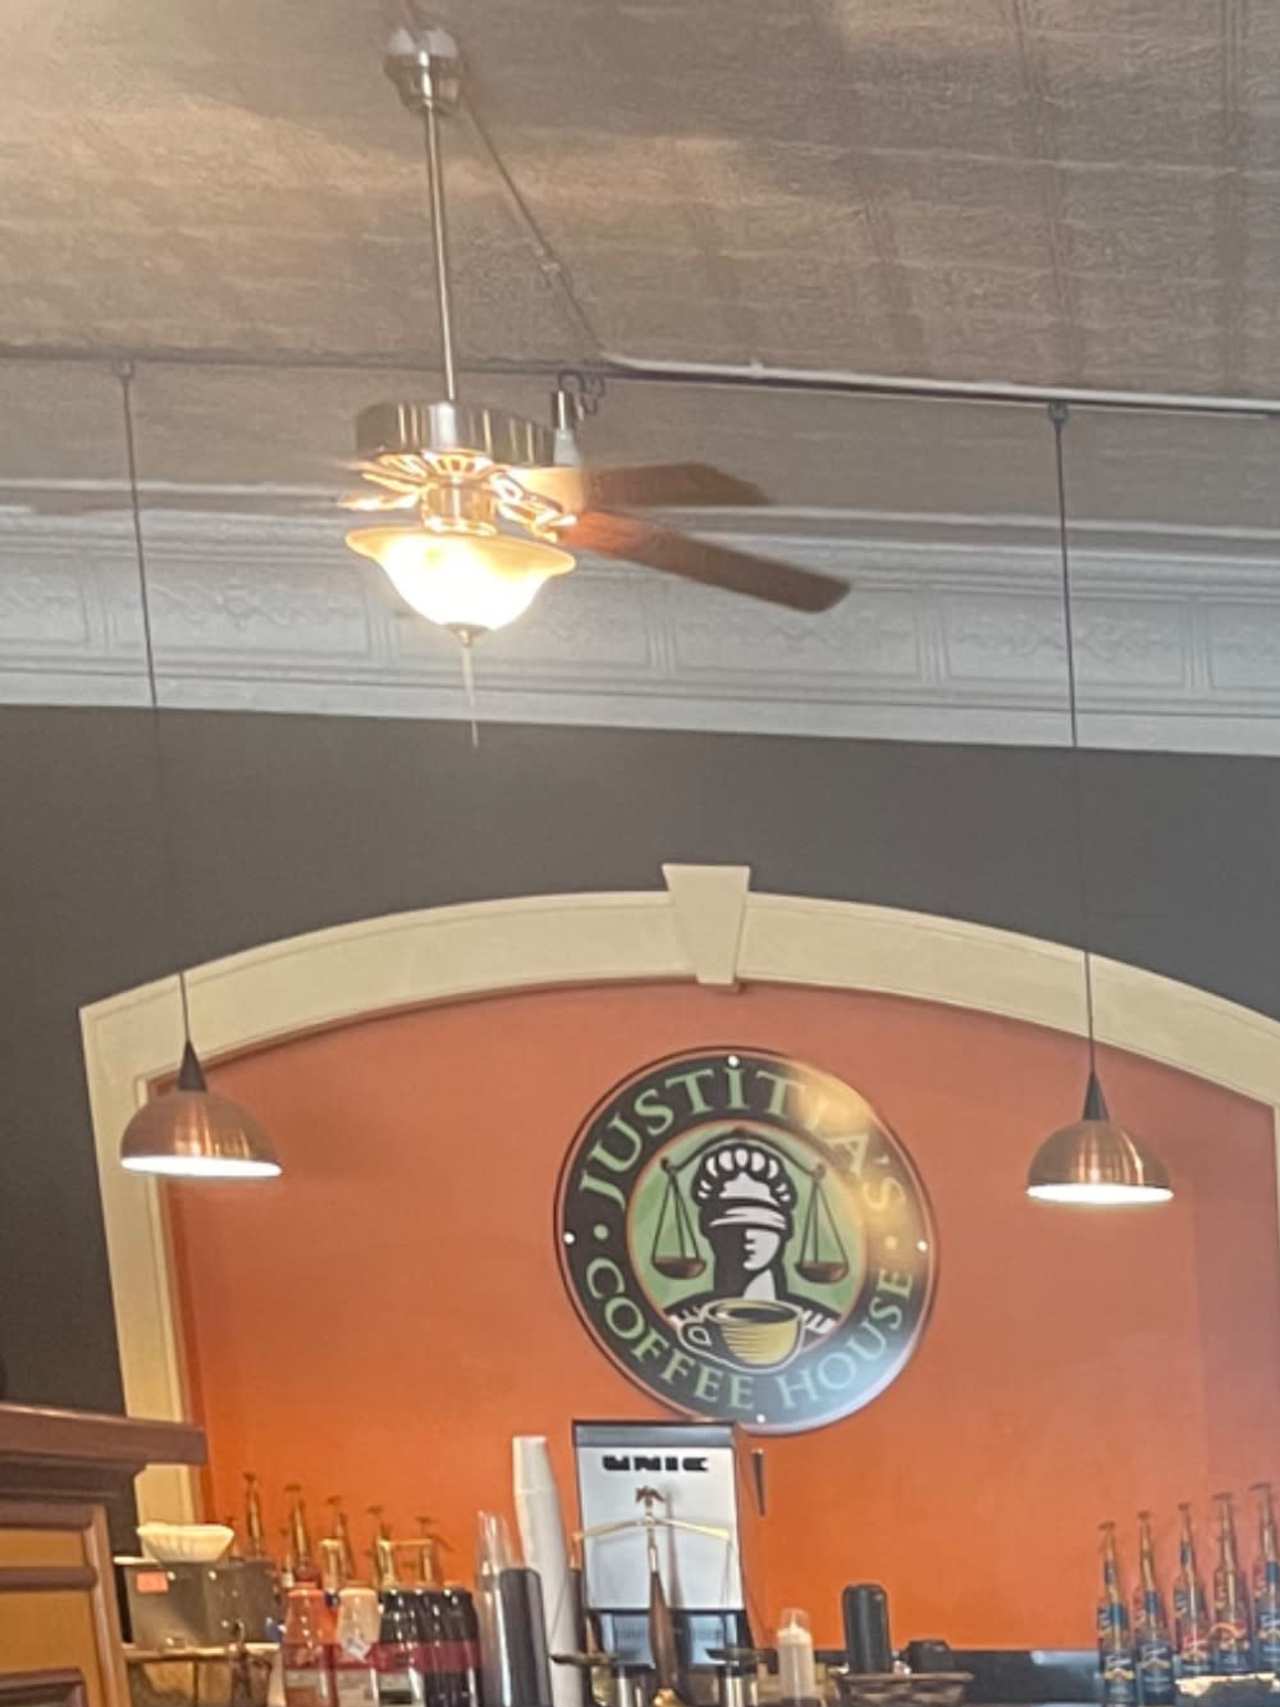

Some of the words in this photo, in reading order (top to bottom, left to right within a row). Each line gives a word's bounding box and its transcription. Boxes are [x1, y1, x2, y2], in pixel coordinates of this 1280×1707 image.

[586, 1258, 755, 1410] COFFEE
[775, 1268, 913, 1408] HOUSE
[602, 1455, 708, 1472] UNIC
